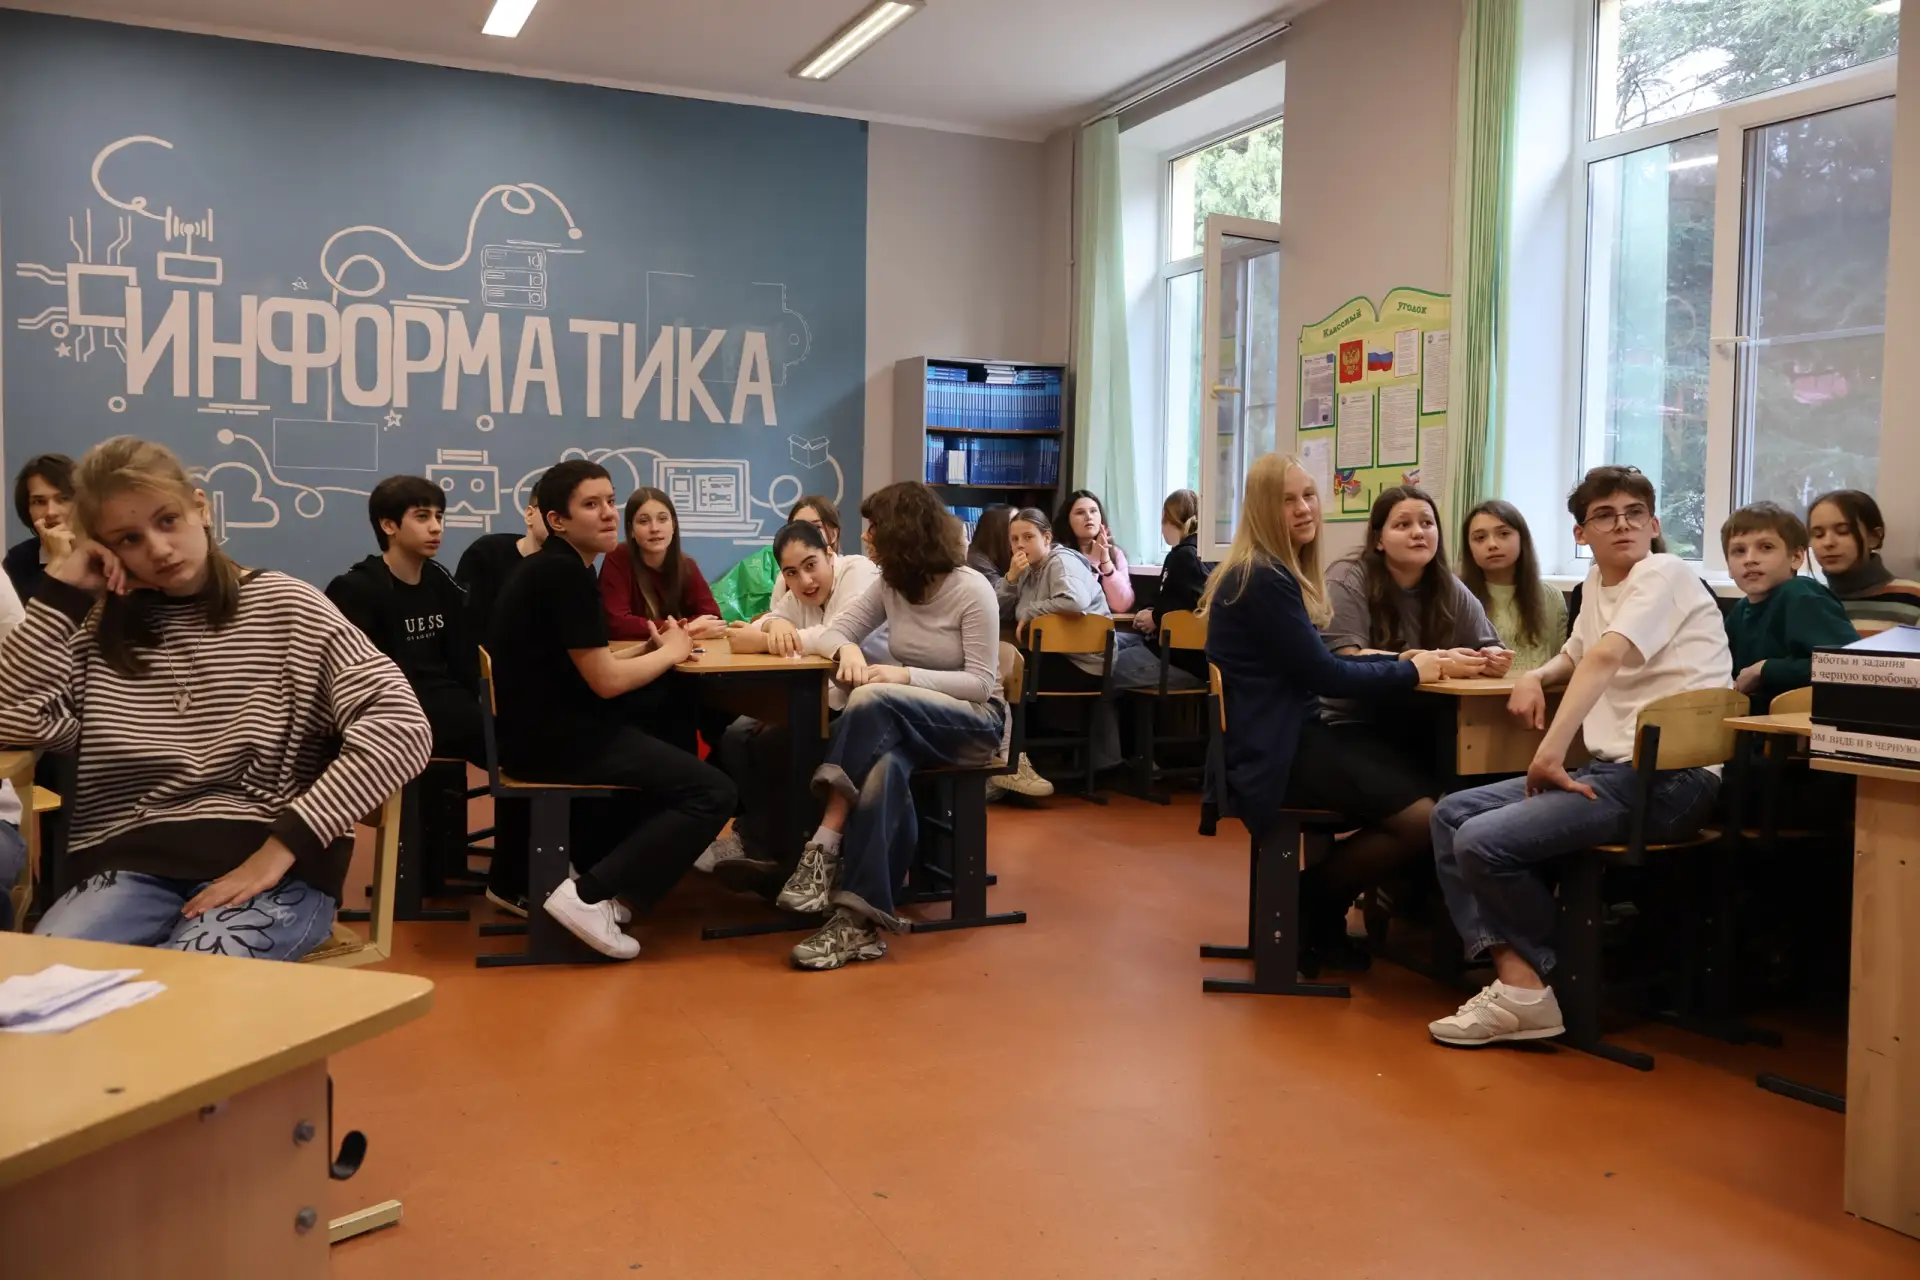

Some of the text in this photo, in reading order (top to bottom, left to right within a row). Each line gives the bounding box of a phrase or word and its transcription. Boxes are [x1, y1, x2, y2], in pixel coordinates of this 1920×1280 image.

[1322, 308, 1362, 338] Классный
[125, 286, 778, 426] ИНФОРМАТИКА
[1812, 654, 1849, 666] Работы
[1862, 658, 1906, 669] задания
[1819, 671, 1859, 682] черную
[1829, 735, 1854, 746] ВИДЕ
[1866, 740, 1872, 748] В
[1875, 741, 1918, 754] ЧЕРНУЮ
